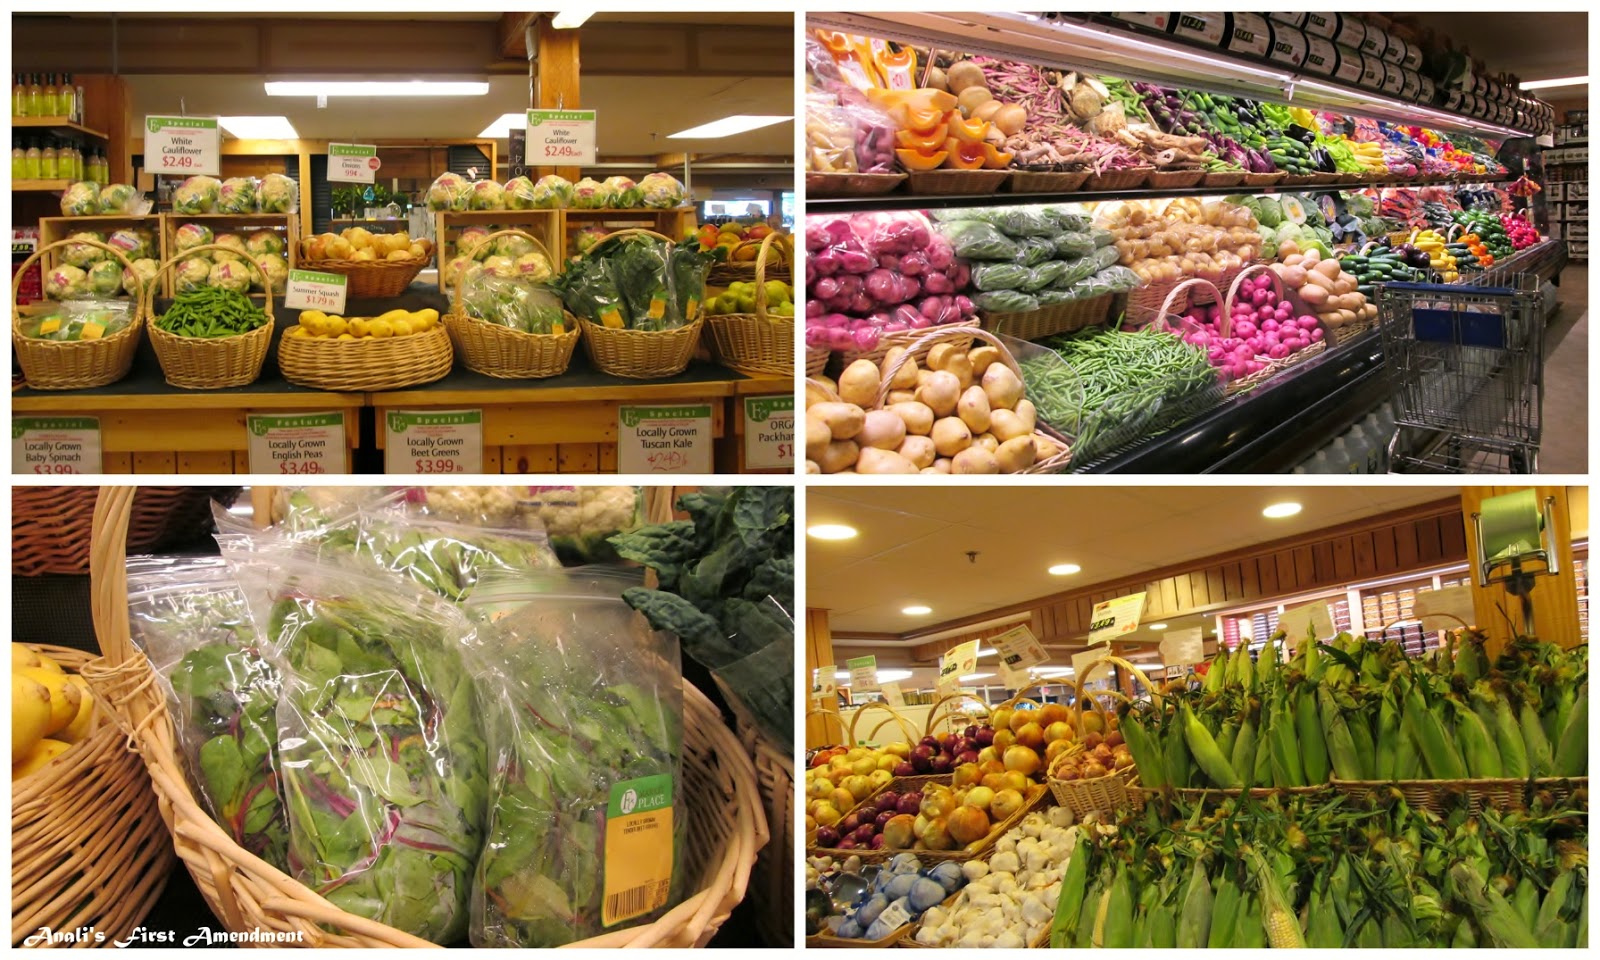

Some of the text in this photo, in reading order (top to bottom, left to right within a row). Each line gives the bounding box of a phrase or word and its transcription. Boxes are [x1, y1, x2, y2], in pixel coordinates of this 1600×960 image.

[168, 120, 204, 128] Special
[553, 129, 570, 137] White
[171, 136, 192, 145] White
[544, 137, 577, 145] Cauliflower
[162, 145, 202, 155] Cauliflower
[545, 145, 571, 157] $2.49
[162, 155, 192, 168] $2.49
[293, 286, 317, 295] Summer
[319, 288, 340, 297] Squash
[306, 294, 327, 306] $1.79
[277, 419, 327, 427] Feature
[417, 416, 465, 424] Special
[637, 427, 697, 440] Locally Grown
[25, 442, 82, 452] Locally Grown
[268, 440, 326, 450] Locally Grown
[407, 437, 464, 448] Locally Grown
[641, 438, 693, 449] Tuscan Kale
[272, 450, 323, 460] English Peas
[411, 448, 460, 457] Beet Greens
[26, 453, 81, 463] Baby Spinach
[280, 461, 318, 474] $3.49
[416, 459, 464, 474] $3.99 lb
[638, 794, 665, 809] PLACE
